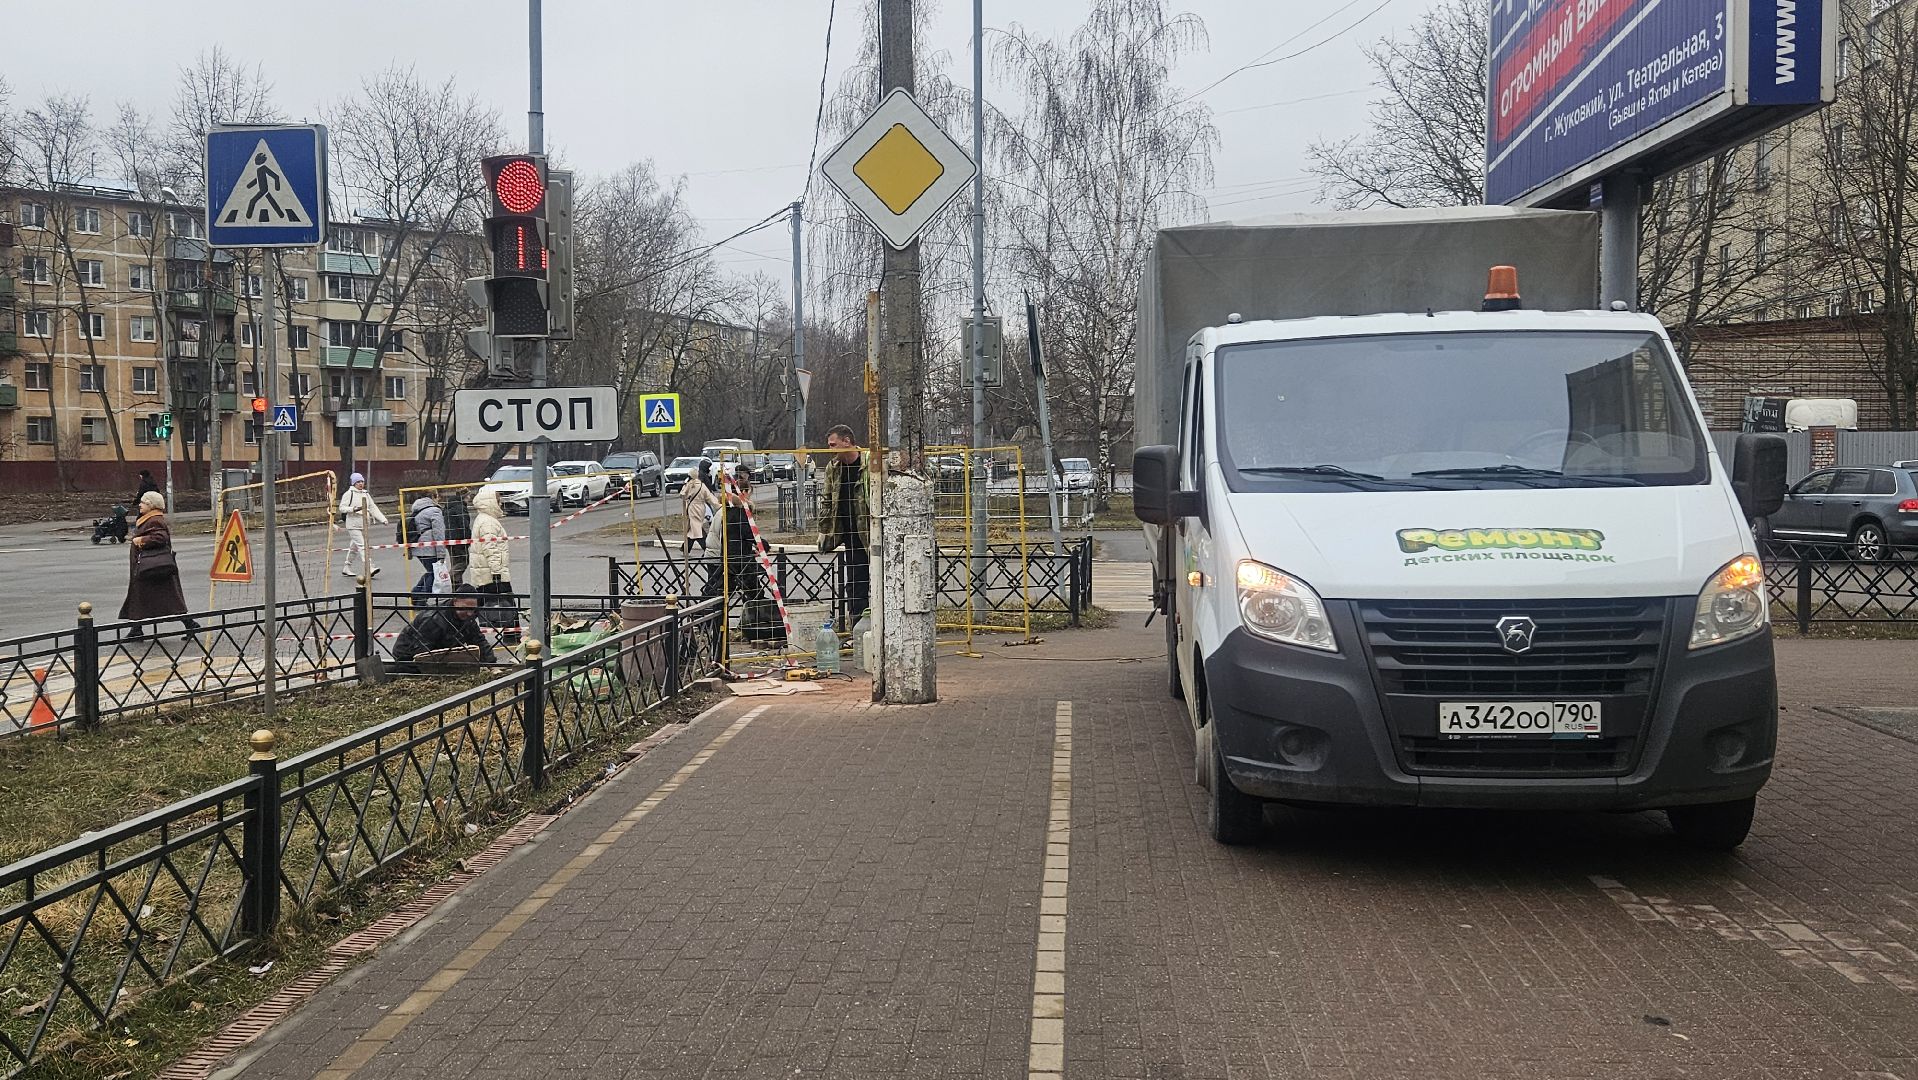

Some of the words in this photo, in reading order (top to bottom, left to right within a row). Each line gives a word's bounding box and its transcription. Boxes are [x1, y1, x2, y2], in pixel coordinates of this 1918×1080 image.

[1501, 5, 1573, 118] ОГРОМНЫЙ
[1544, 127, 1553, 142] г.
[1554, 88, 1606, 137] Жуковкий,
[1608, 82, 1624, 109] ул.
[1627, 29, 1710, 92] Театральная,
[1714, 11, 1723, 41] 3
[1608, 96, 1646, 130] (Бывшие
[1647, 82, 1671, 107] Яхты
[1672, 78, 1679, 94] и
[1681, 49, 1723, 89] Катера)
[478, 397, 593, 432] СТОП
[1404, 552, 1495, 566] детских
[1500, 551, 1616, 563] площадок
[1448, 705, 1550, 729] А342ОО
[1555, 704, 1593, 722] 790
